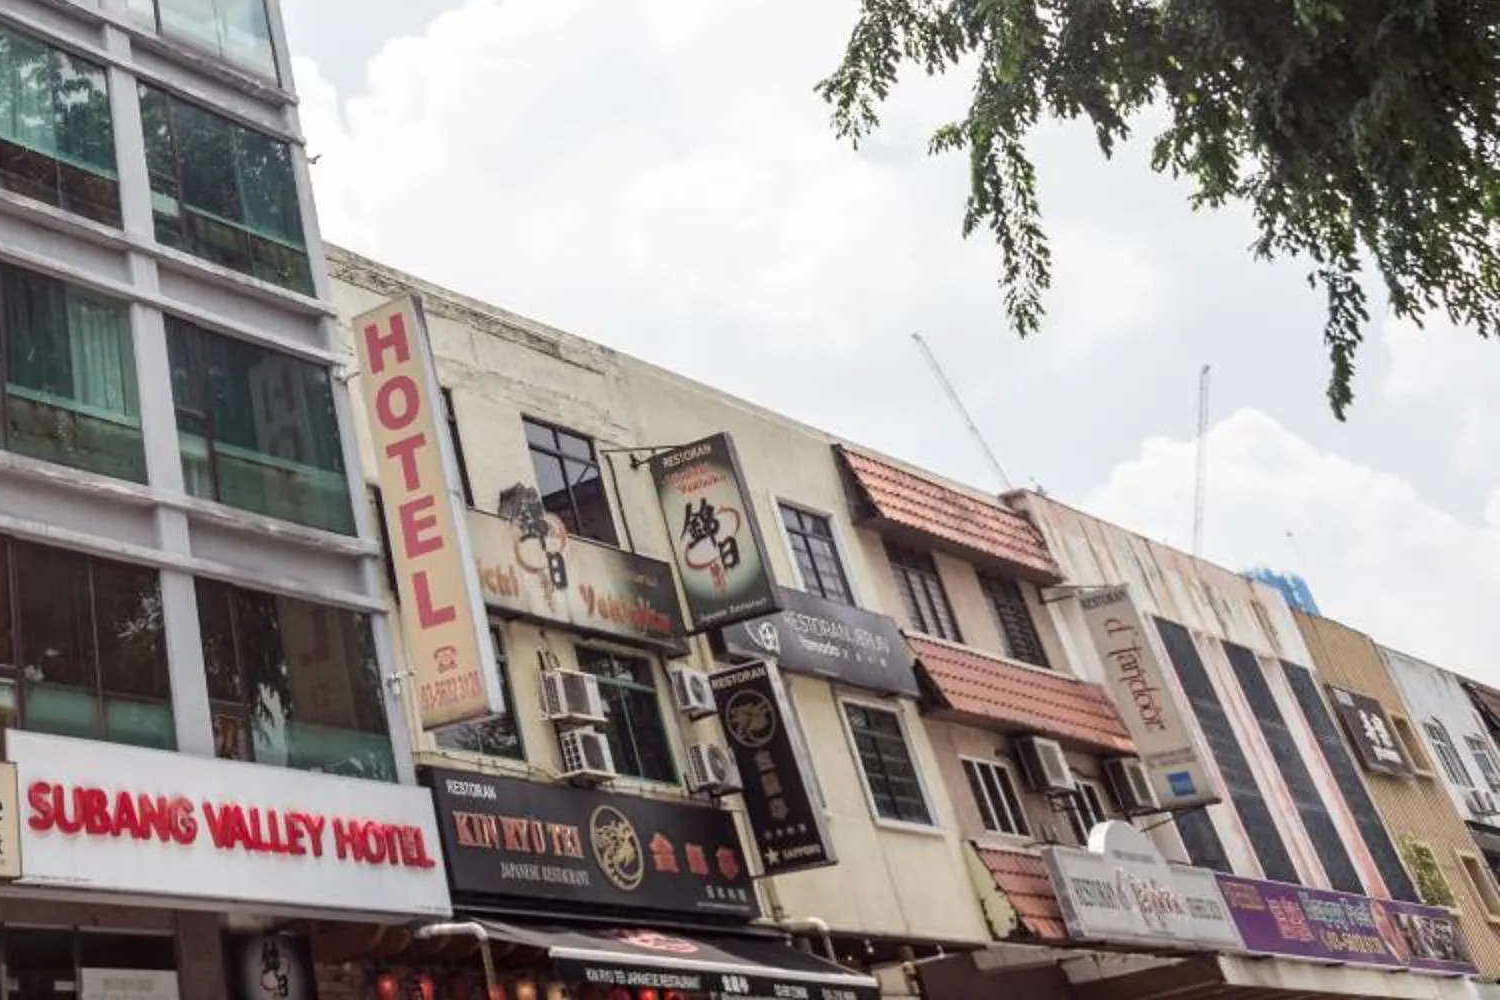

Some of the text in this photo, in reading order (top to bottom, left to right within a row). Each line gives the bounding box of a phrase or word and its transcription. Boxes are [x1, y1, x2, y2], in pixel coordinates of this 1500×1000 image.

[363, 313, 456, 630] HOTEL
[711, 665, 768, 690] RESTORAN
[27, 780, 436, 870] SUBANG VALLEY HOTEL
[452, 810, 499, 850] KIN
